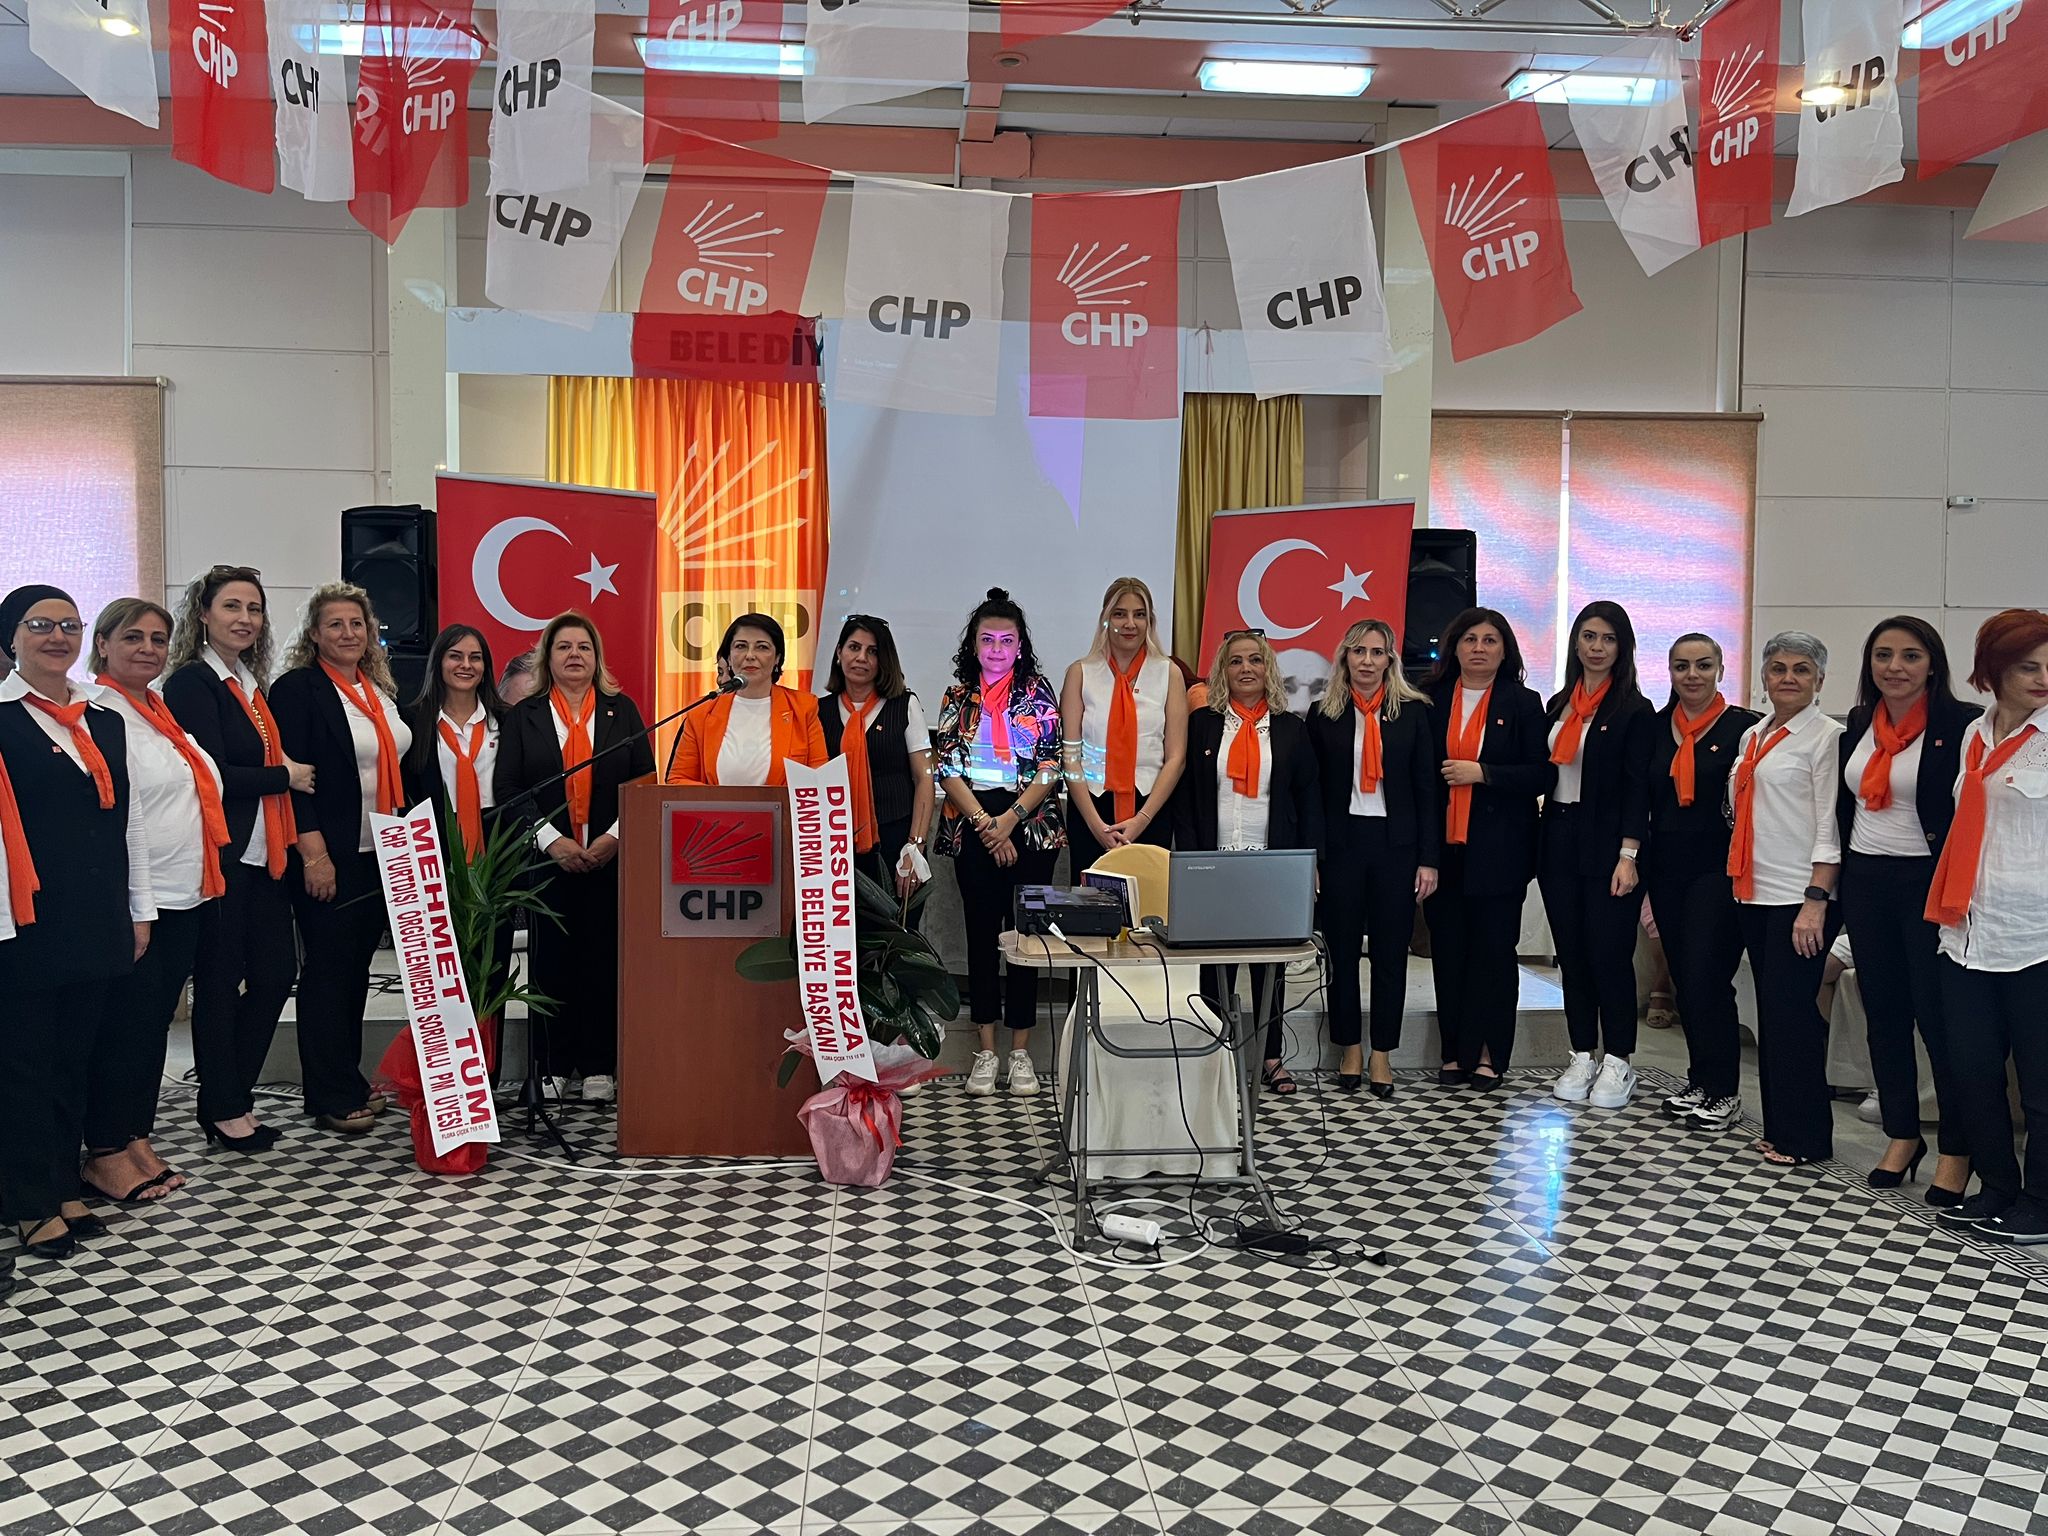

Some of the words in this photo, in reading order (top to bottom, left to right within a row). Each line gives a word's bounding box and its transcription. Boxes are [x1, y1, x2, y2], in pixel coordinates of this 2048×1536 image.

[192, 26, 238, 89] CHP
[402, 89, 455, 135] CHP
[499, 58, 562, 117] CHP
[1709, 116, 1760, 167] CHP
[495, 194, 592, 247] CHP
[1460, 230, 1540, 283] CHP
[676, 267, 768, 315] CHP
[868, 295, 972, 340] CHP
[1266, 275, 1363, 330] CHP
[1060, 312, 1149, 348] CHP
[379, 825, 406, 848] CHP
[795, 787, 823, 878] BANDIRMA
[826, 785, 851, 927] DURSUN
[386, 854, 419, 907] YURTDIŞI
[680, 890, 763, 920] CHP
[801, 888, 831, 972] BELEDİYE
[410, 818, 465, 1003] MEHMET
[455, 1027, 491, 1124] TÜM
[804, 982, 839, 1054] BAŞKANI
[833, 950, 864, 1052] MİRZA
[417, 1014, 451, 1069] SORUMLU
[428, 1072, 455, 1092] PM
[432, 1094, 470, 1132] ÜYESİ
